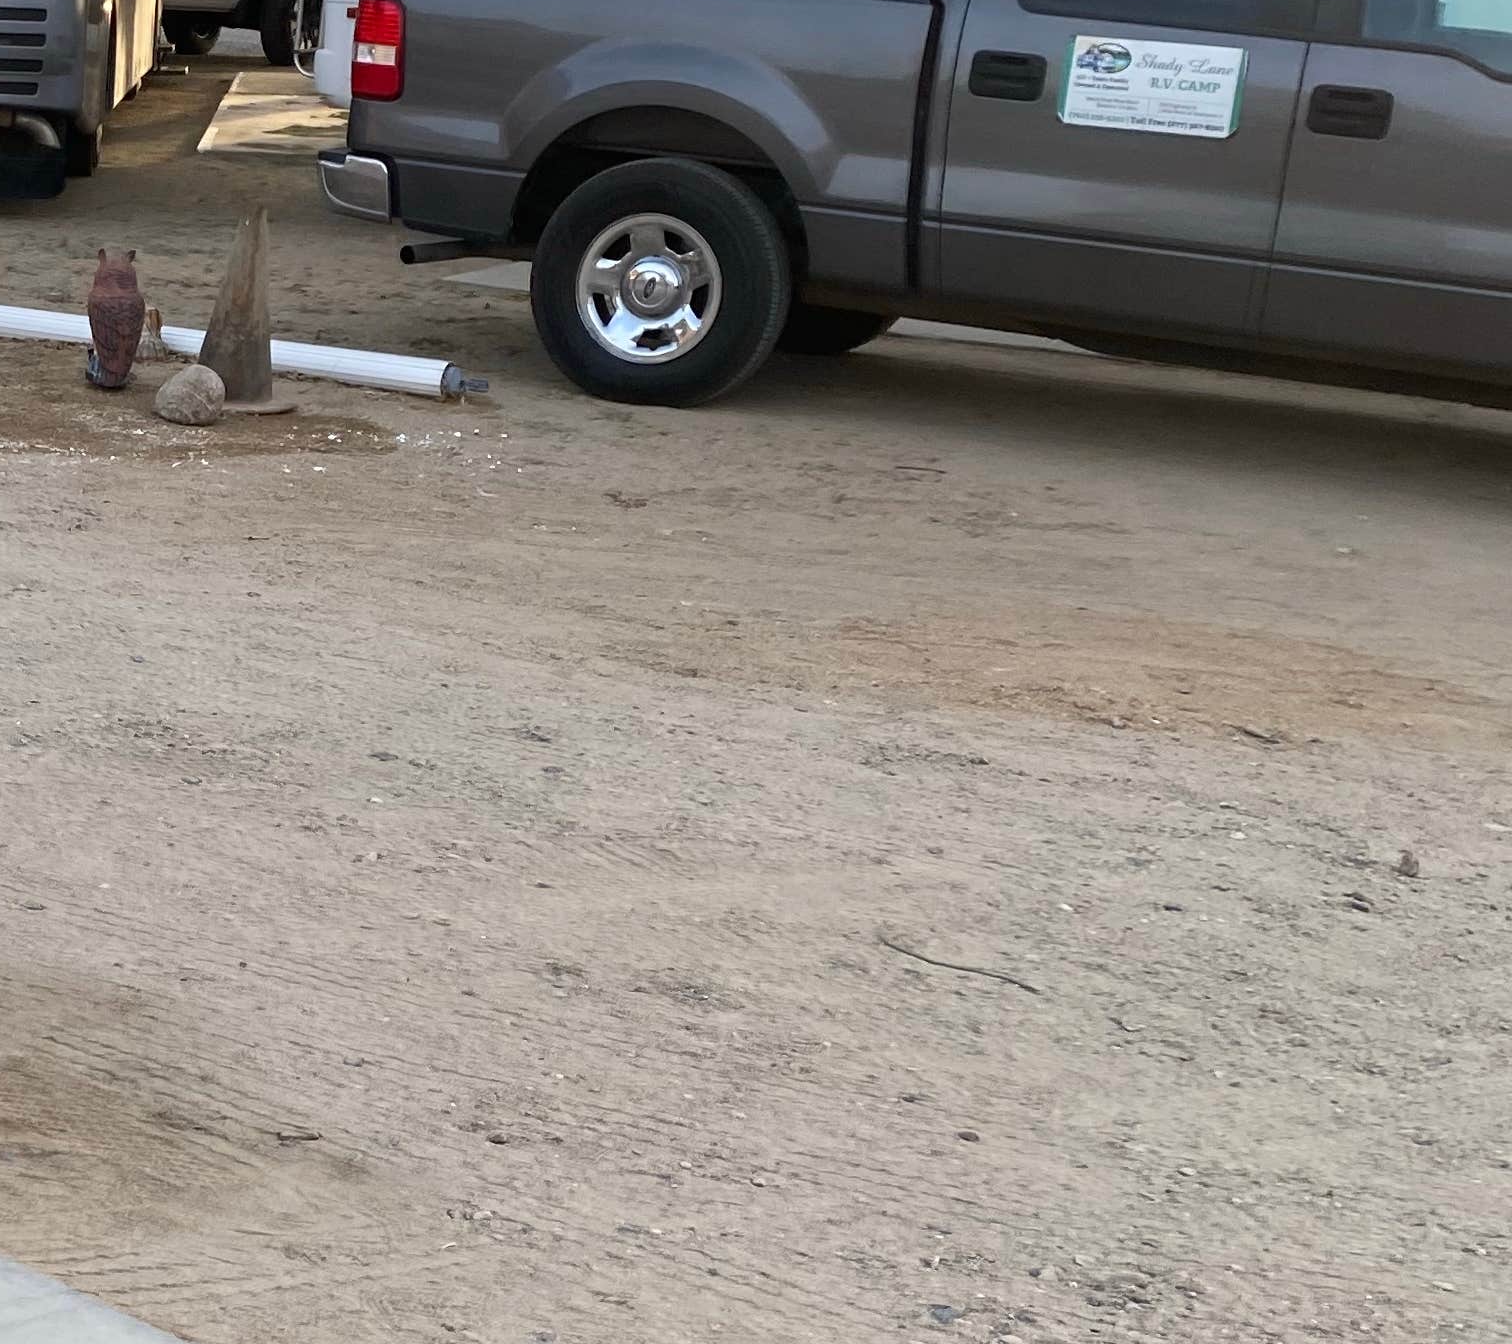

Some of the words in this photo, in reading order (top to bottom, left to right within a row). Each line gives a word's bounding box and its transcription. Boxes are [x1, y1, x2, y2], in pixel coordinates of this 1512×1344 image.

[1135, 52, 1184, 77] Shady
[1189, 58, 1235, 75] Lane
[1178, 79, 1221, 93] CAMP
